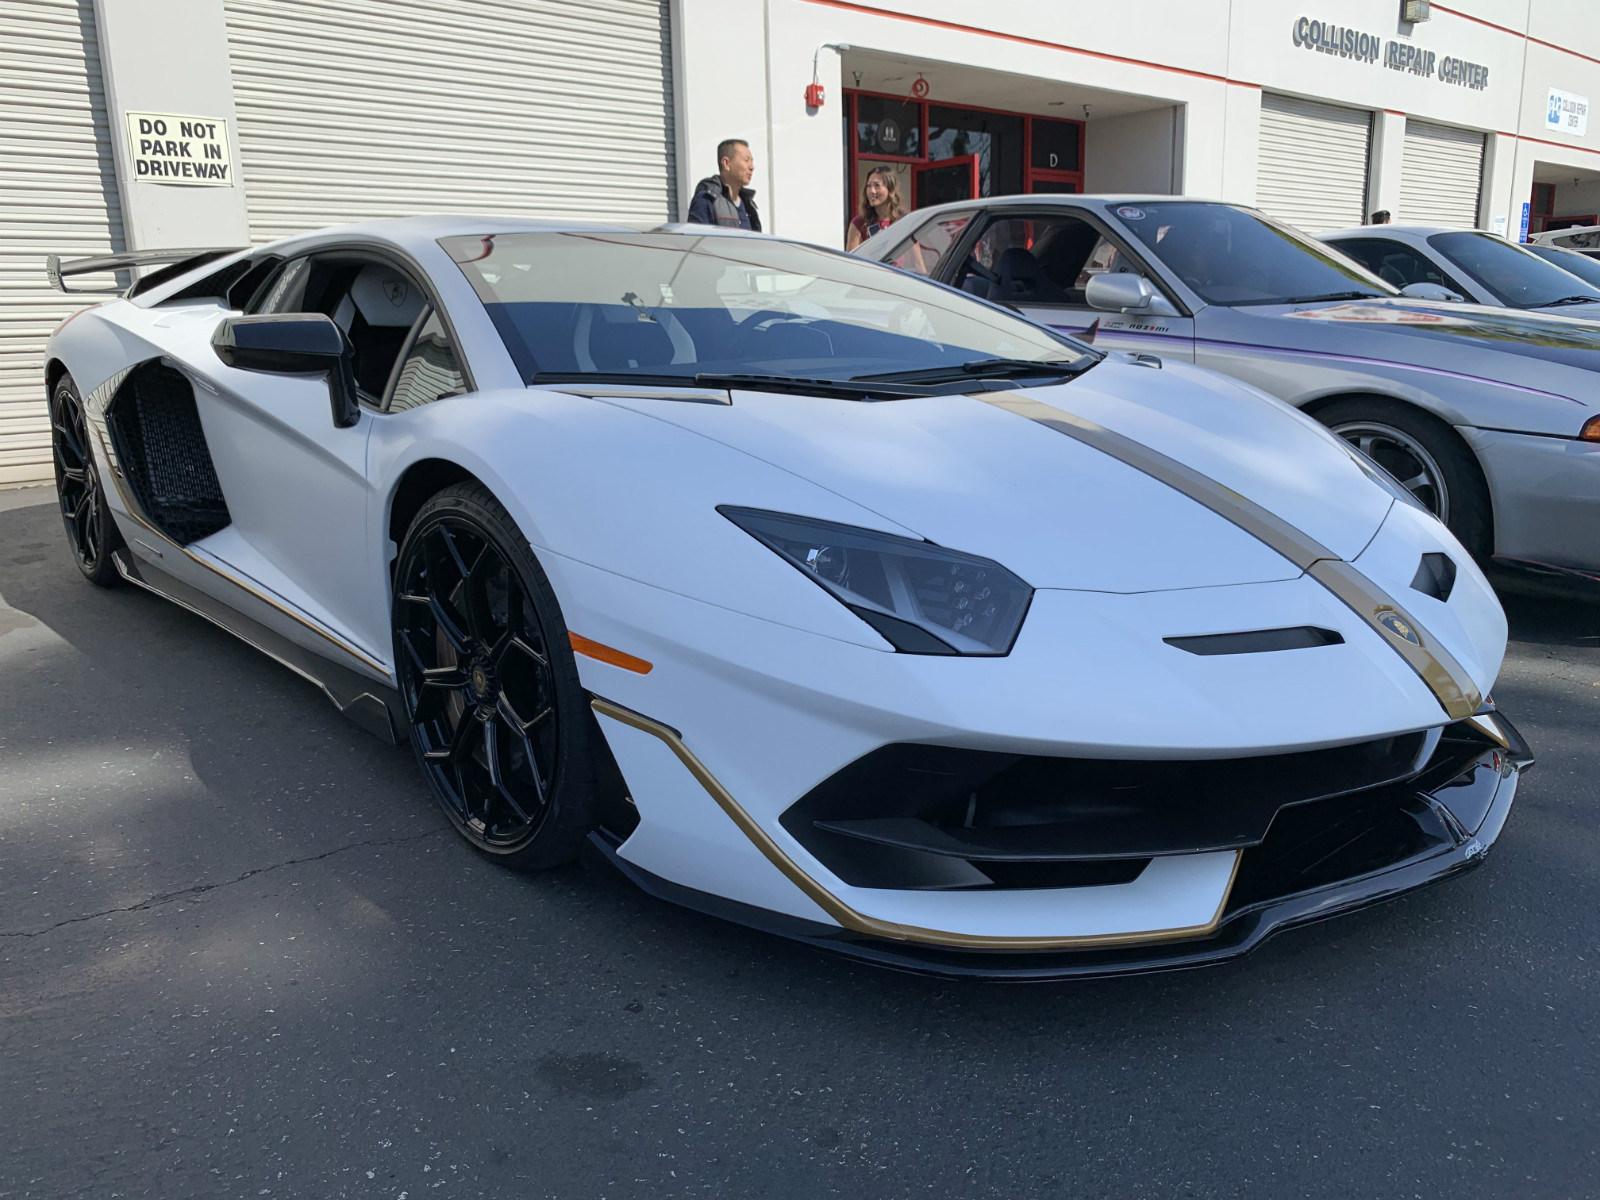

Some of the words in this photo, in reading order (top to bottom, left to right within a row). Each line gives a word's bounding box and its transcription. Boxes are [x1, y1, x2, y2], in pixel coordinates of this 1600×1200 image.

[1295, 16, 1380, 60] COLLISION
[1386, 40, 1436, 74] REPAIR
[1439, 55, 1489, 88] CENTER
[139, 118, 167, 136] DO
[180, 121, 216, 139] NOT
[140, 139, 192, 158] PARK
[203, 143, 222, 159] IN
[136, 159, 228, 179] DRIVEWAY
[1049, 153, 1058, 168] D
